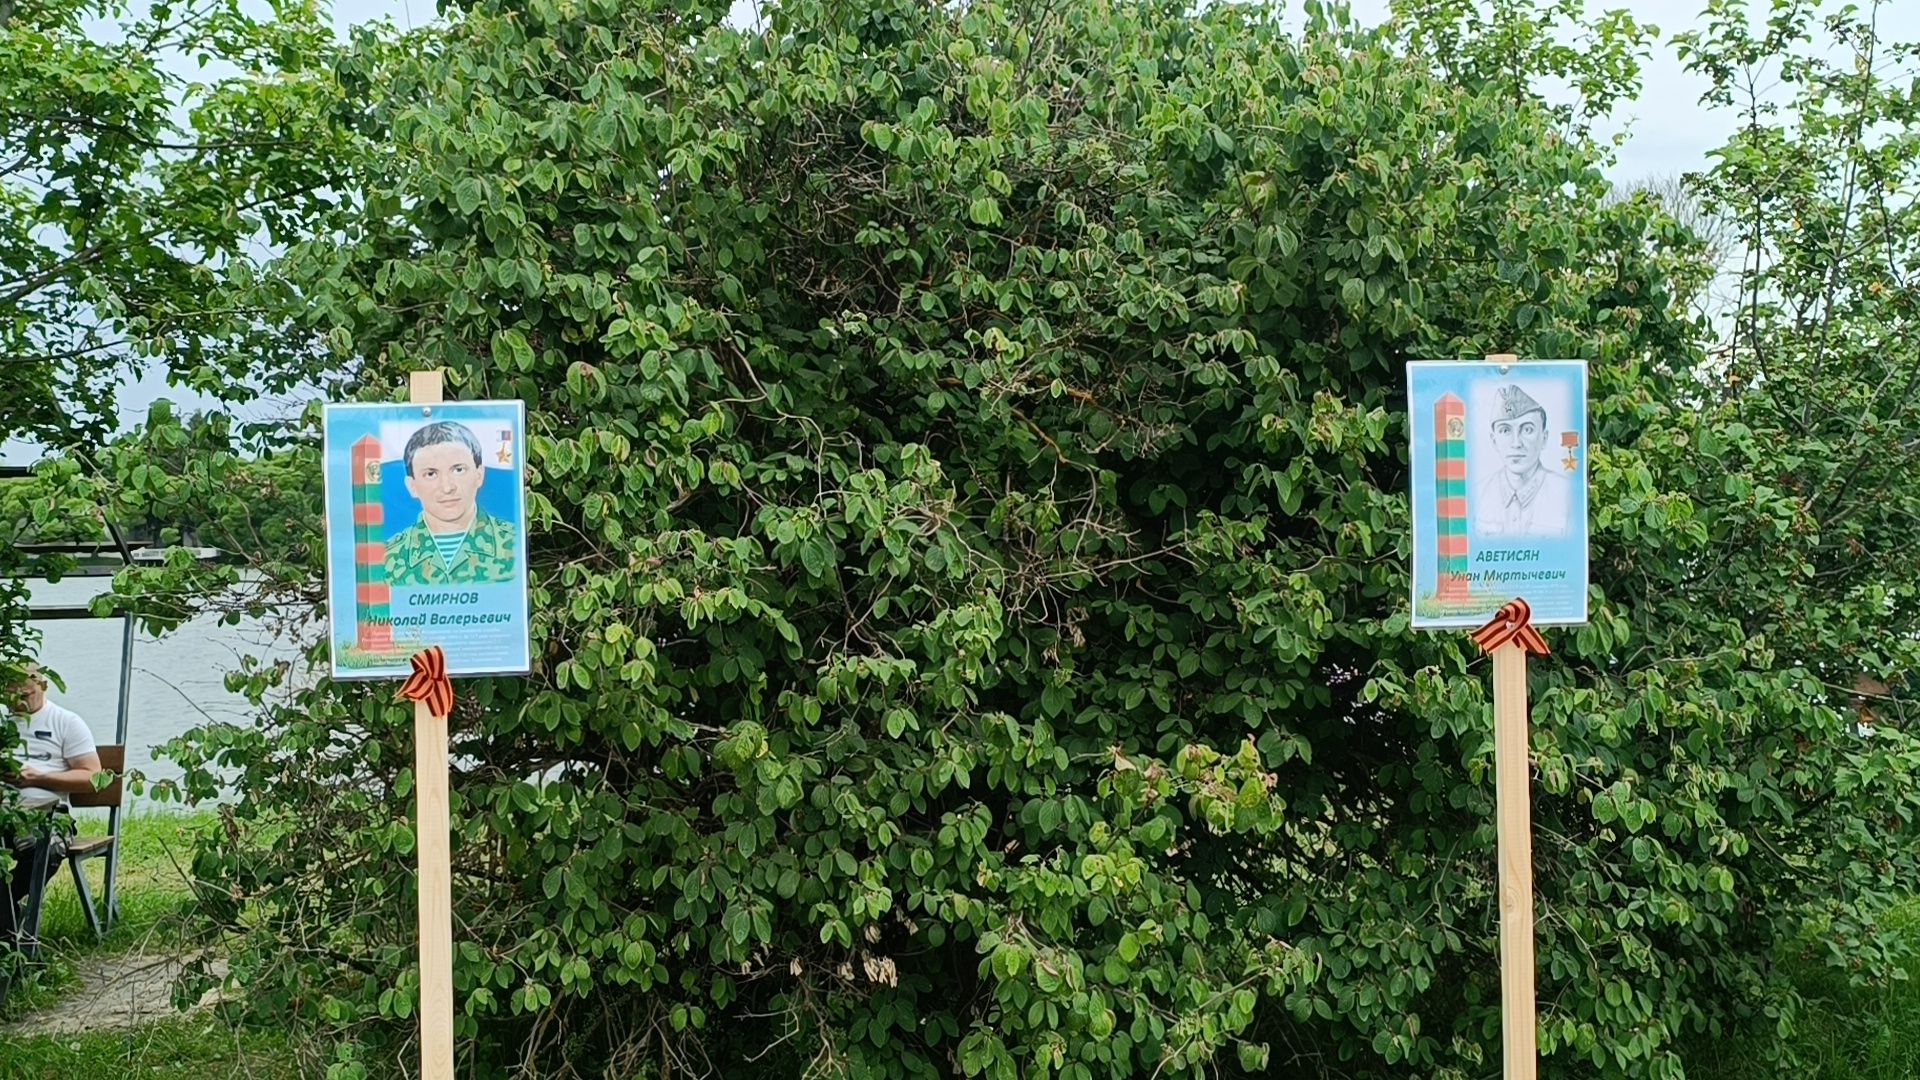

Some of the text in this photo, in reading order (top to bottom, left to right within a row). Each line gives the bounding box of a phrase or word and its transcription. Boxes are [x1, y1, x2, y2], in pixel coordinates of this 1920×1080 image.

[1476, 550, 1540, 562] АВЕТИСЯН
[1450, 569, 1566, 583] Унан Мкртычевич
[409, 592, 479, 605] СМИРНОВ
[368, 612, 511, 626] Николай Валерьевич
